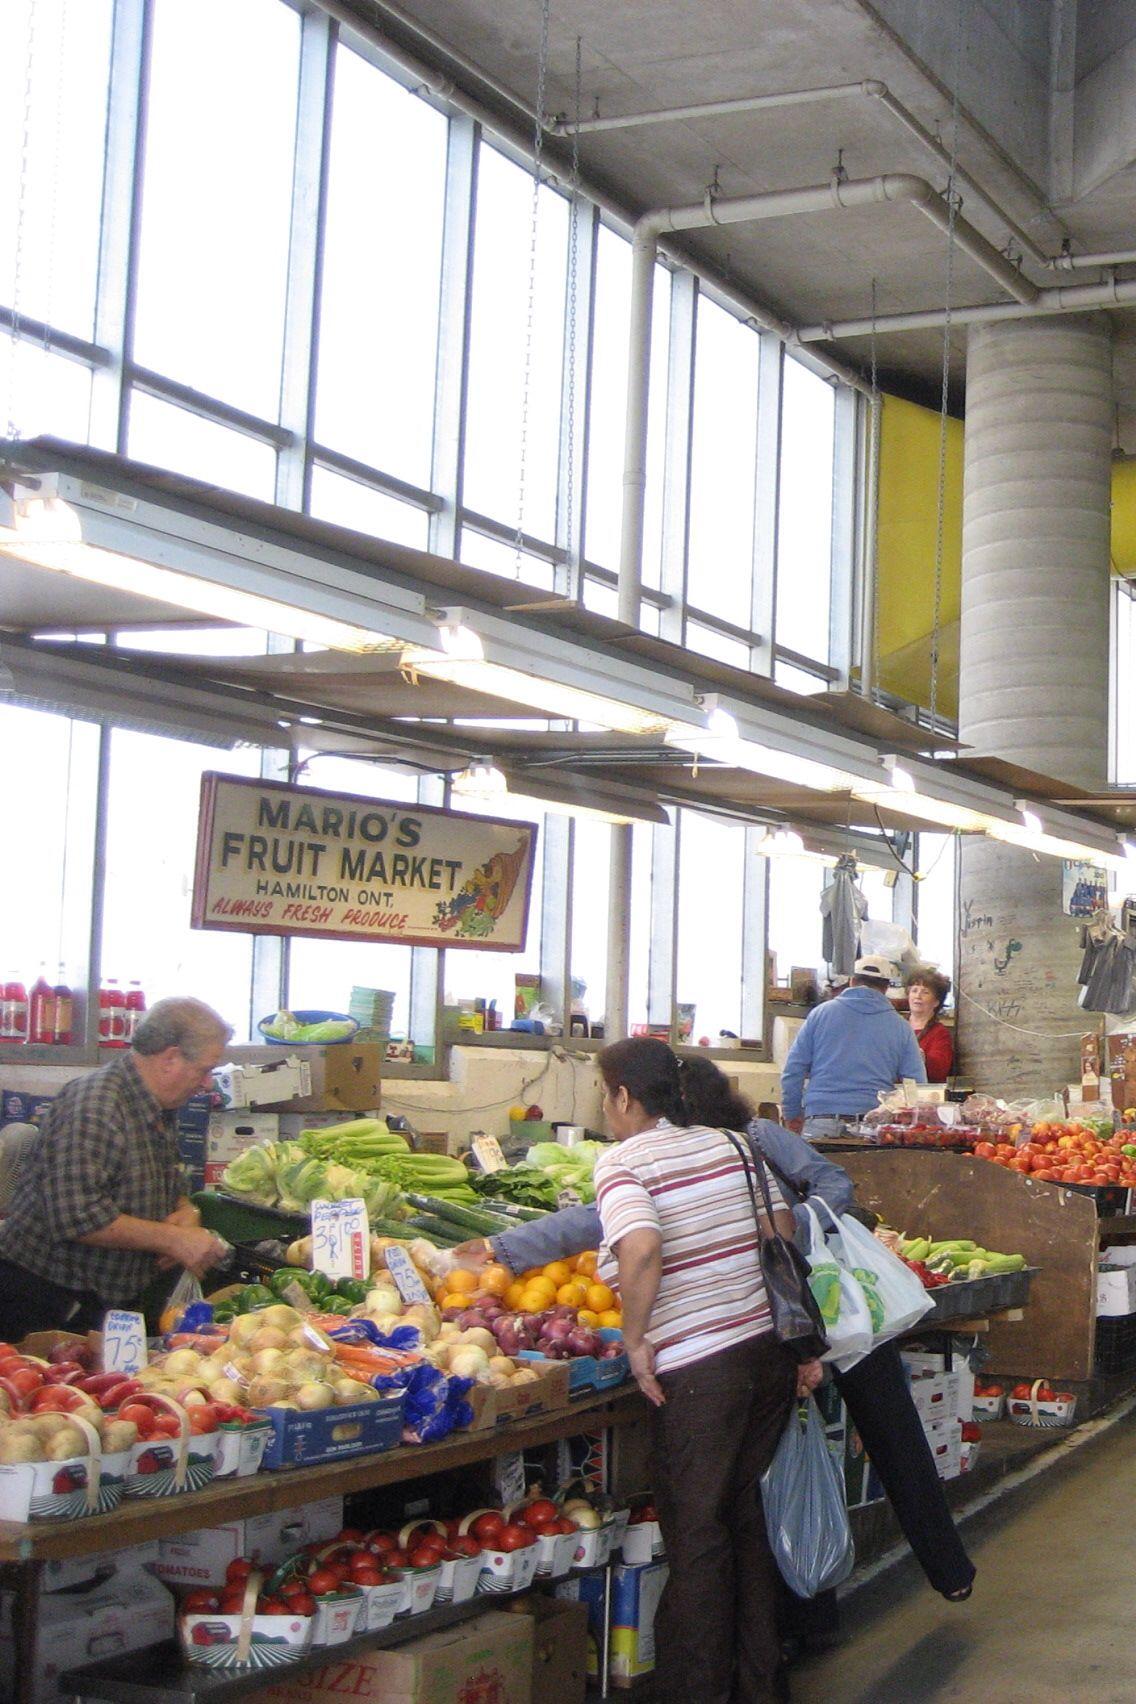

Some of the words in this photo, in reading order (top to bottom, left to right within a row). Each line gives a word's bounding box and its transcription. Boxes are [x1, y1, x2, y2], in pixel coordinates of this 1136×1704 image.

[258, 797, 423, 848] MARIO'S
[220, 831, 327, 877] FRUIT
[341, 848, 463, 892] MARKET
[256, 879, 350, 904] HAMILTON
[211, 897, 272, 920] ALWAYS
[283, 905, 333, 924] FRESH
[341, 909, 409, 930] PRODUCE
[152, 1563, 211, 1580] TOMATOES
